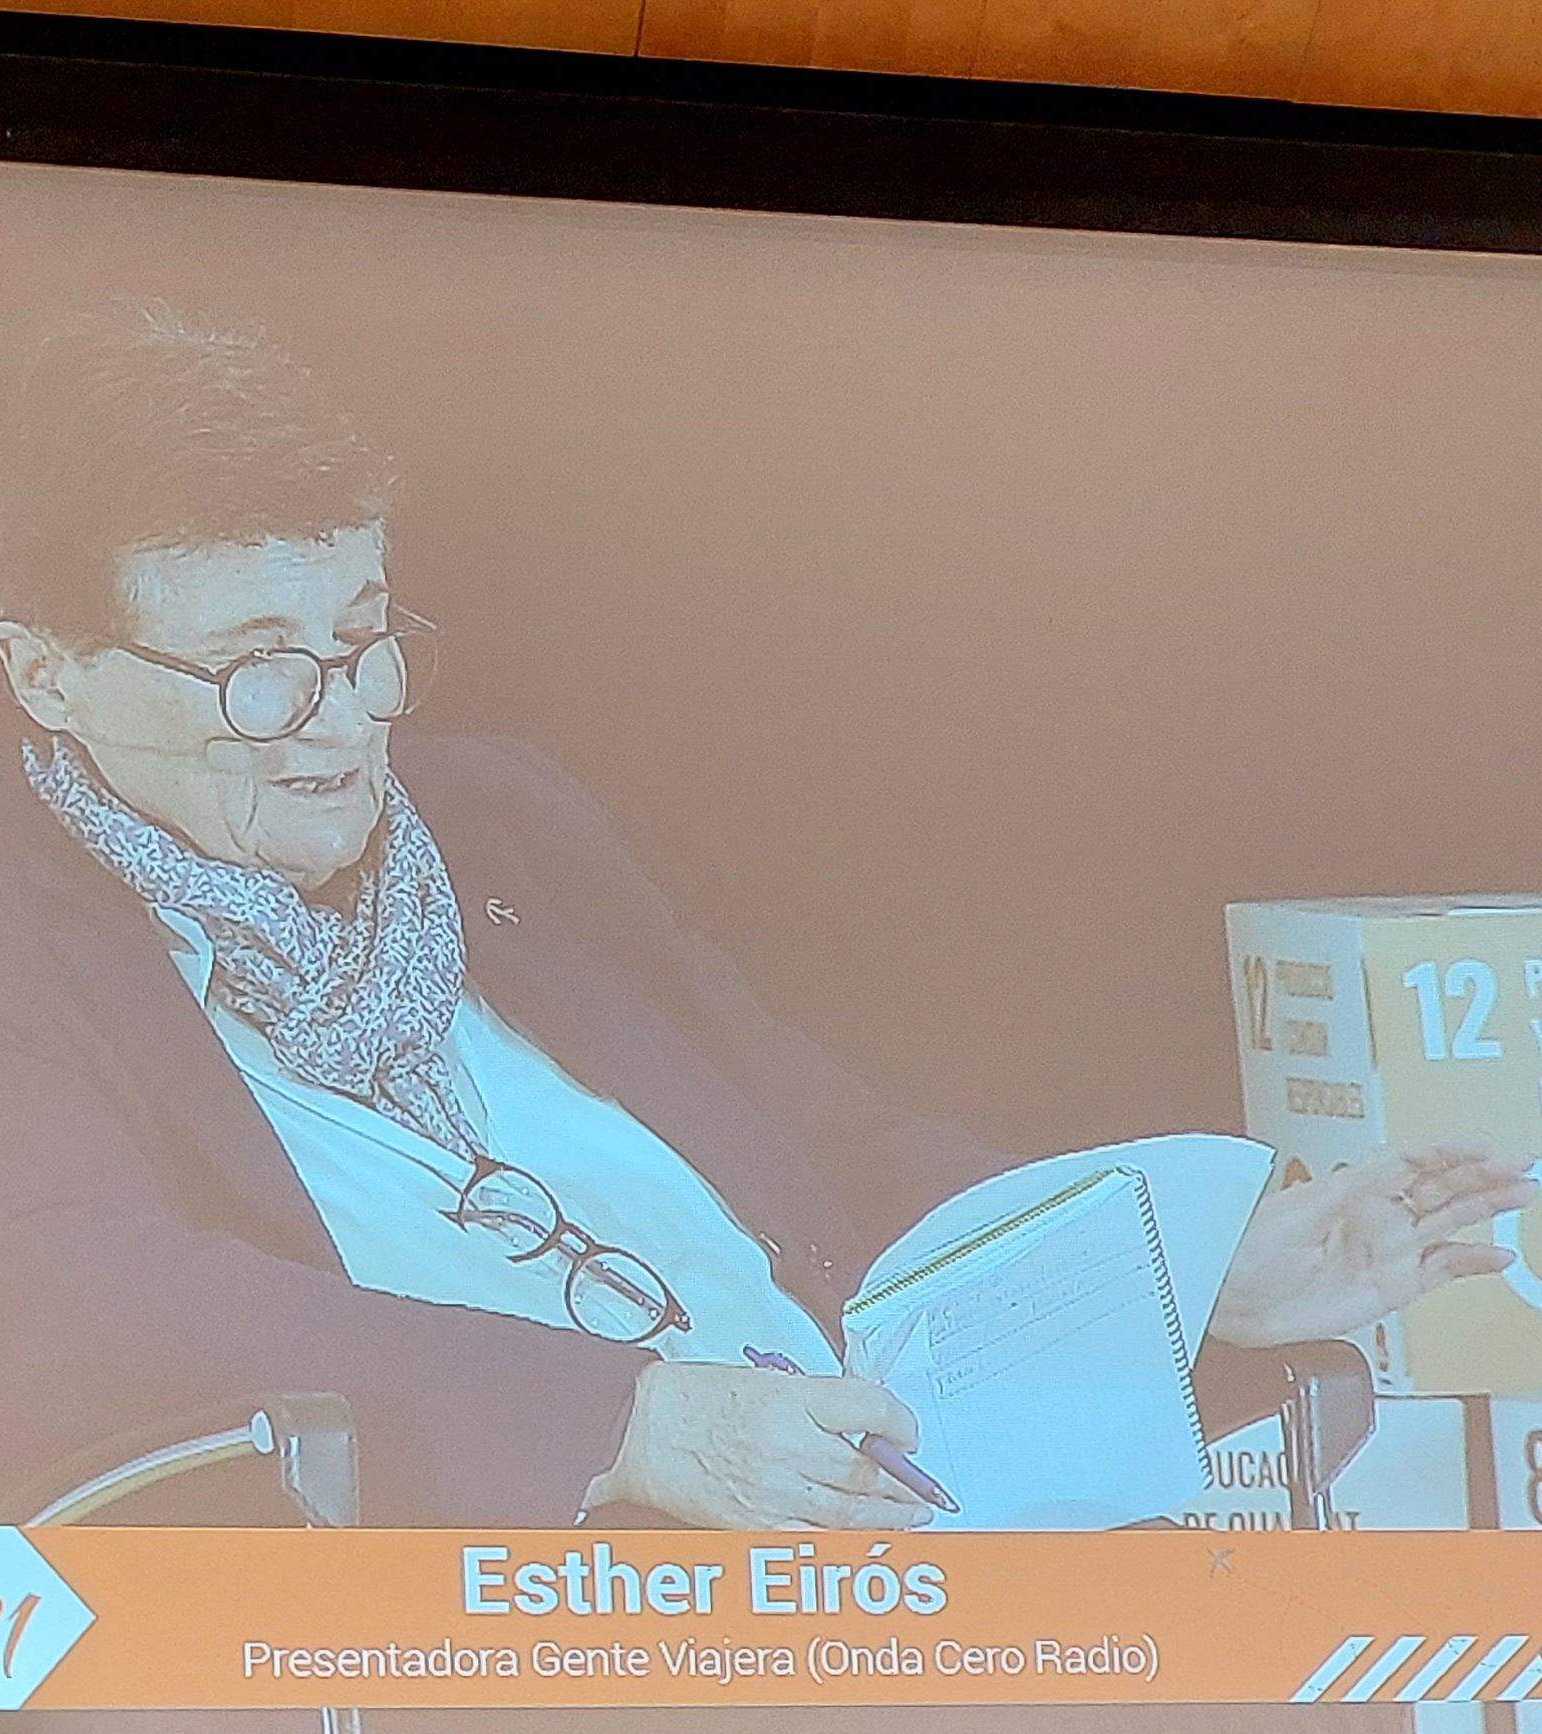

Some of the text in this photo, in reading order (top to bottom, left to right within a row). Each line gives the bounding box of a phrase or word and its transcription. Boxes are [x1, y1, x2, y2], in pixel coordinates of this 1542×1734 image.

[1402, 957, 1504, 1061] 12
[461, 1542, 949, 1617] Esther Eirós
[242, 1639, 1160, 1684] Presentadora Gente Viajera (Onda Cero Radio)
